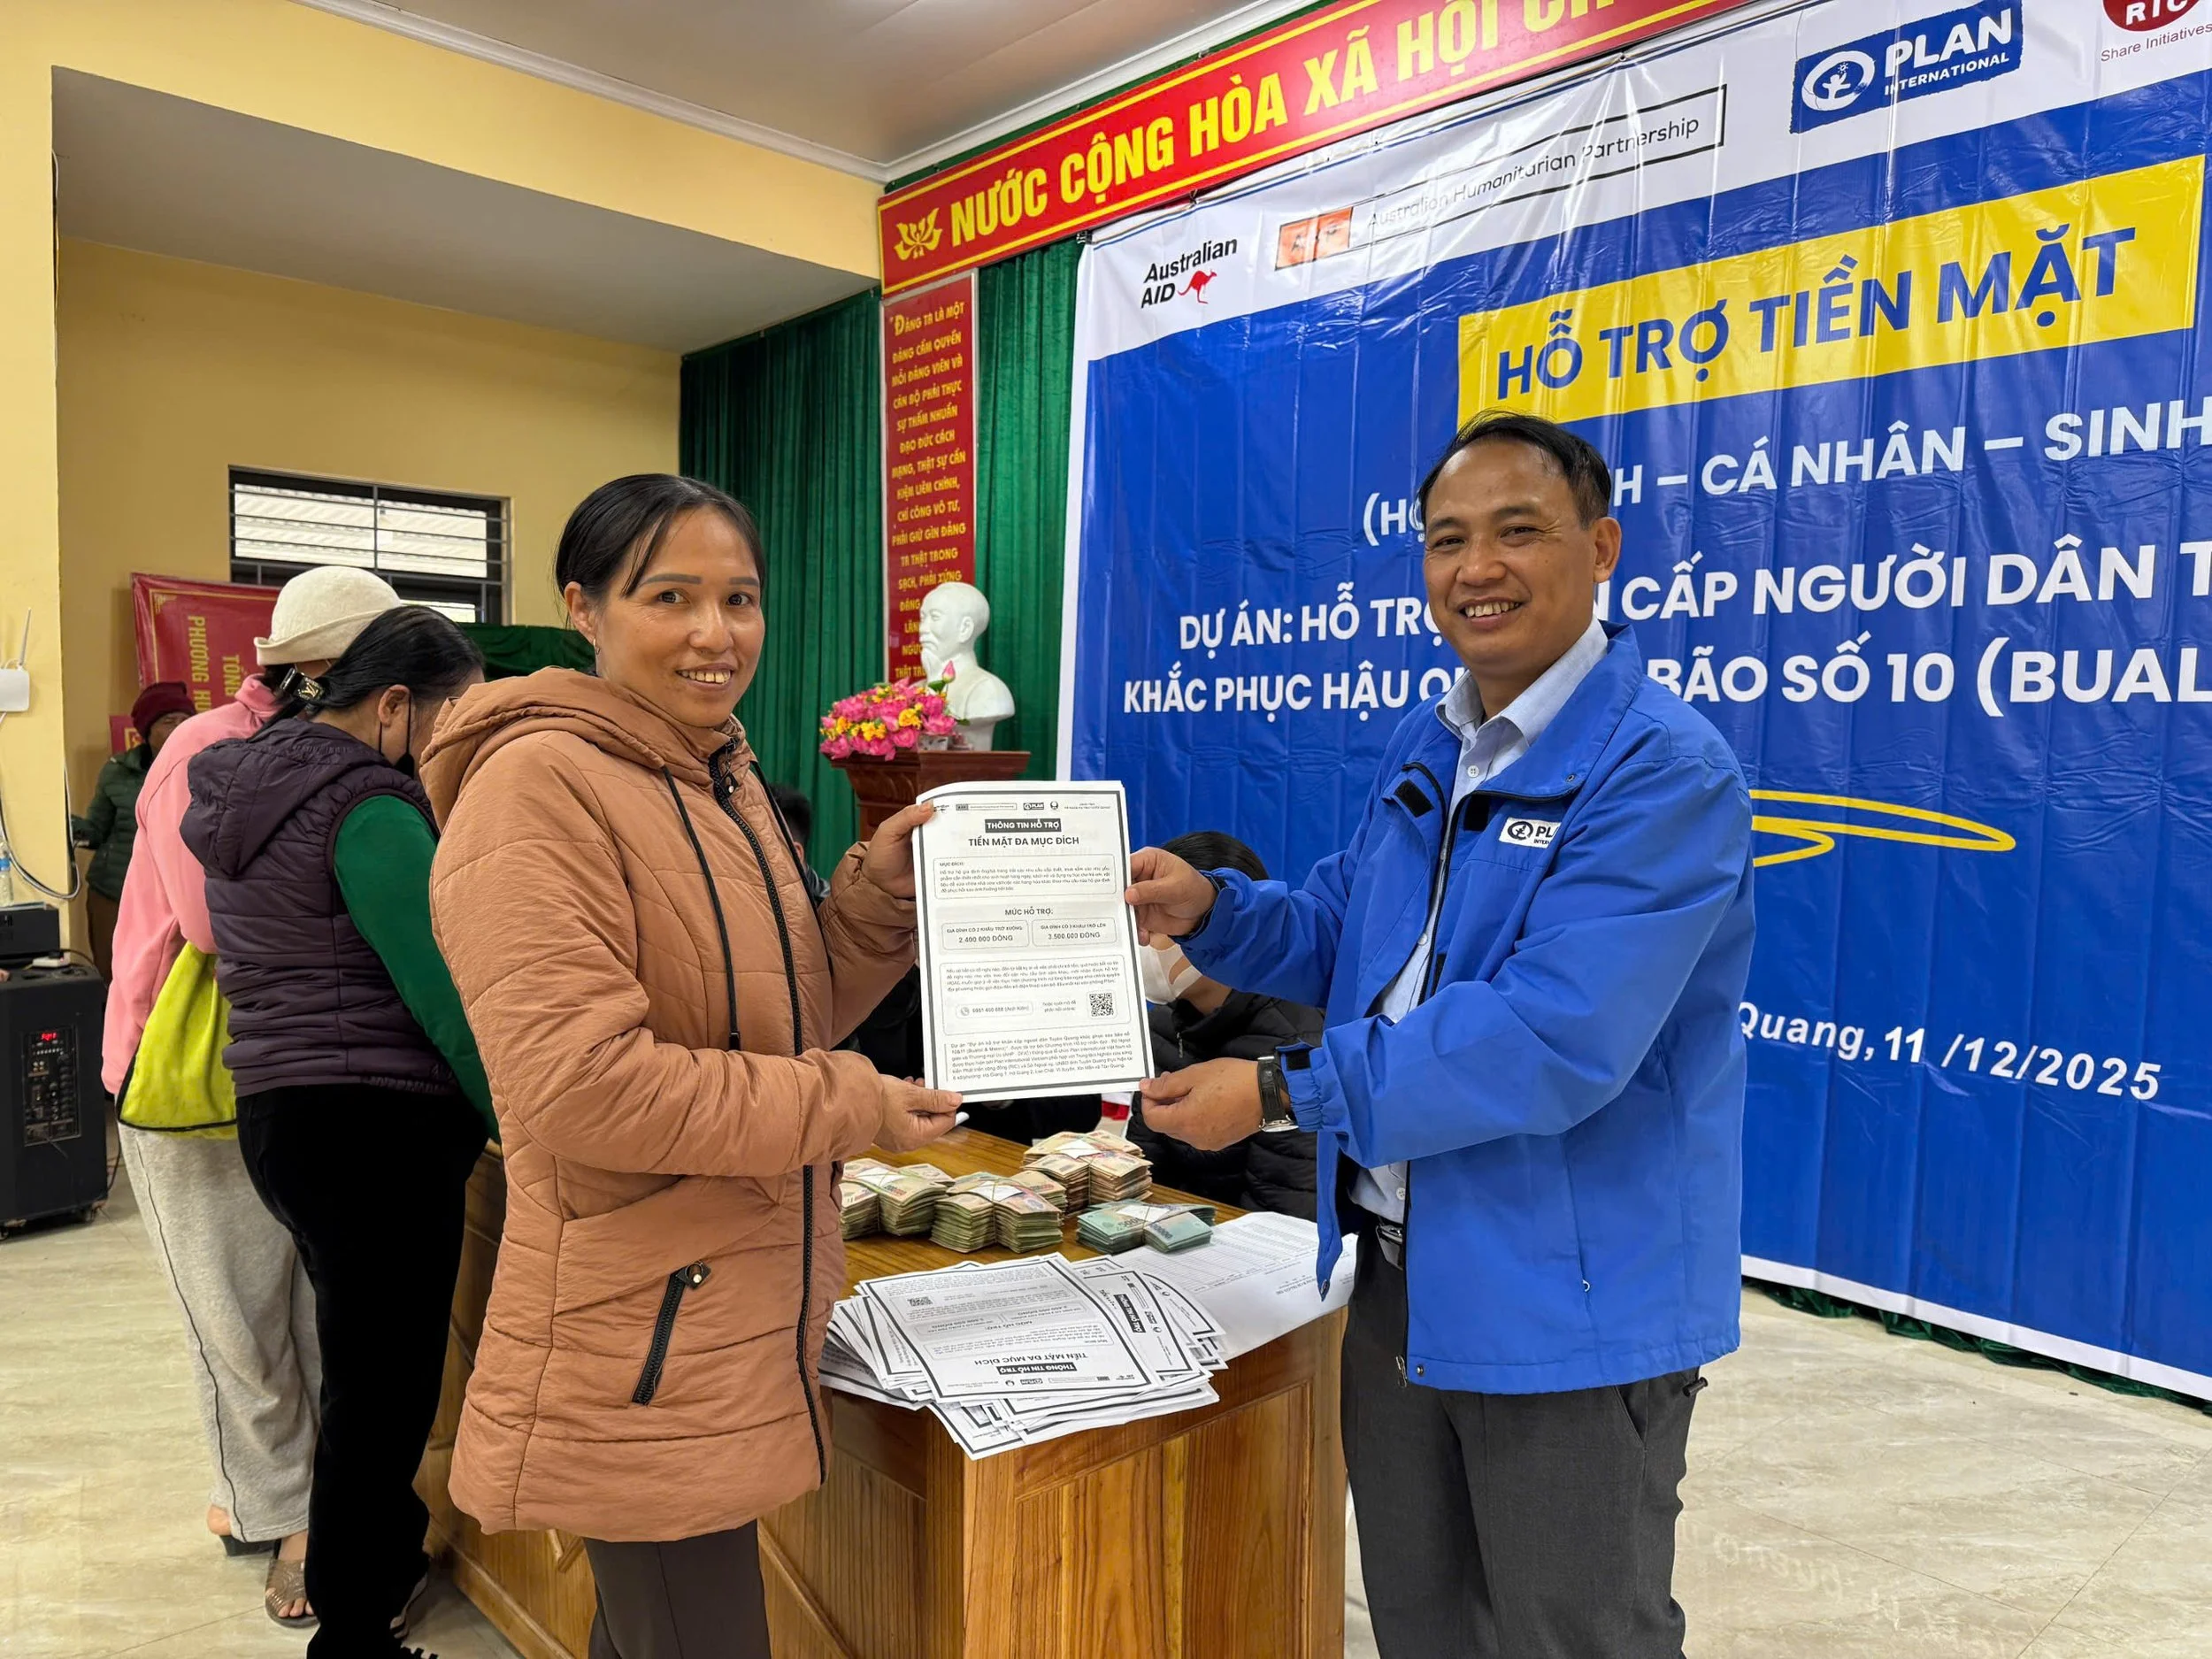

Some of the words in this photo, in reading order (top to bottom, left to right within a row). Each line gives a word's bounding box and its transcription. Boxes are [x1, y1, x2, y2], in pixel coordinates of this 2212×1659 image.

[1885, 7, 2013, 78] PLAN
[2101, 42, 2141, 63] Share
[2146, 23, 2212, 50] Initiatives
[1885, 54, 2009, 96] INTERNATIONAL
[951, 167, 1048, 247] NƯỚC
[1059, 116, 1175, 204] CỘNG
[1188, 73, 1289, 157] HÒA
[1302, 25, 1379, 116] XÃ
[1368, 191, 1448, 227] Australian
[1453, 152, 1576, 202] Humanitarian
[1581, 117, 1700, 168] Partnership
[1143, 238, 1238, 284] Australian
[934, 306, 945, 323] LÀ
[946, 301, 965, 319] MỘT
[1141, 282, 1176, 309] AID
[1497, 310, 1582, 400] HỖ
[1599, 297, 1730, 382] TRỢ
[1749, 254, 1911, 356] TIỀN
[1939, 224, 2137, 327] MẶT
[1701, 435, 1777, 495] CÁ
[1791, 420, 1966, 488] NHÂN
[2044, 396, 2212, 462] SINH
[910, 505, 932, 519] CÔNG
[933, 499, 946, 515] VÔ
[929, 547, 958, 562] TRONG
[1179, 608, 1225, 660] DỰ
[1231, 599, 1294, 647] ÁN:
[1300, 581, 1360, 643] HỖ
[1621, 551, 1739, 622] CẤP
[1753, 542, 1967, 616] NGƯỜI
[1986, 533, 2156, 606] DÂN
[188, 616, 209, 683] PHƯƠNG
[1123, 660, 1208, 714] KHẮC
[1215, 673, 1312, 723] PHỤC
[1322, 659, 1409, 722] HẬU
[1647, 645, 1768, 703] BÃO
[1782, 629, 1870, 703] SỐ
[1886, 652, 1955, 703] 10
[992, 836, 1013, 848] MẶT
[1015, 837, 1029, 846] ĐA
[1031, 837, 1054, 848] MỤC
[1056, 835, 1079, 845] ĐÍCH
[1031, 818, 1043, 829] HỖ
[1044, 819, 1060, 830] TRỢ
[1738, 1001, 1875, 1062] Quang,
[1884, 1026, 1926, 1064] 11
[1940, 1033, 2162, 1102] /12/2025
